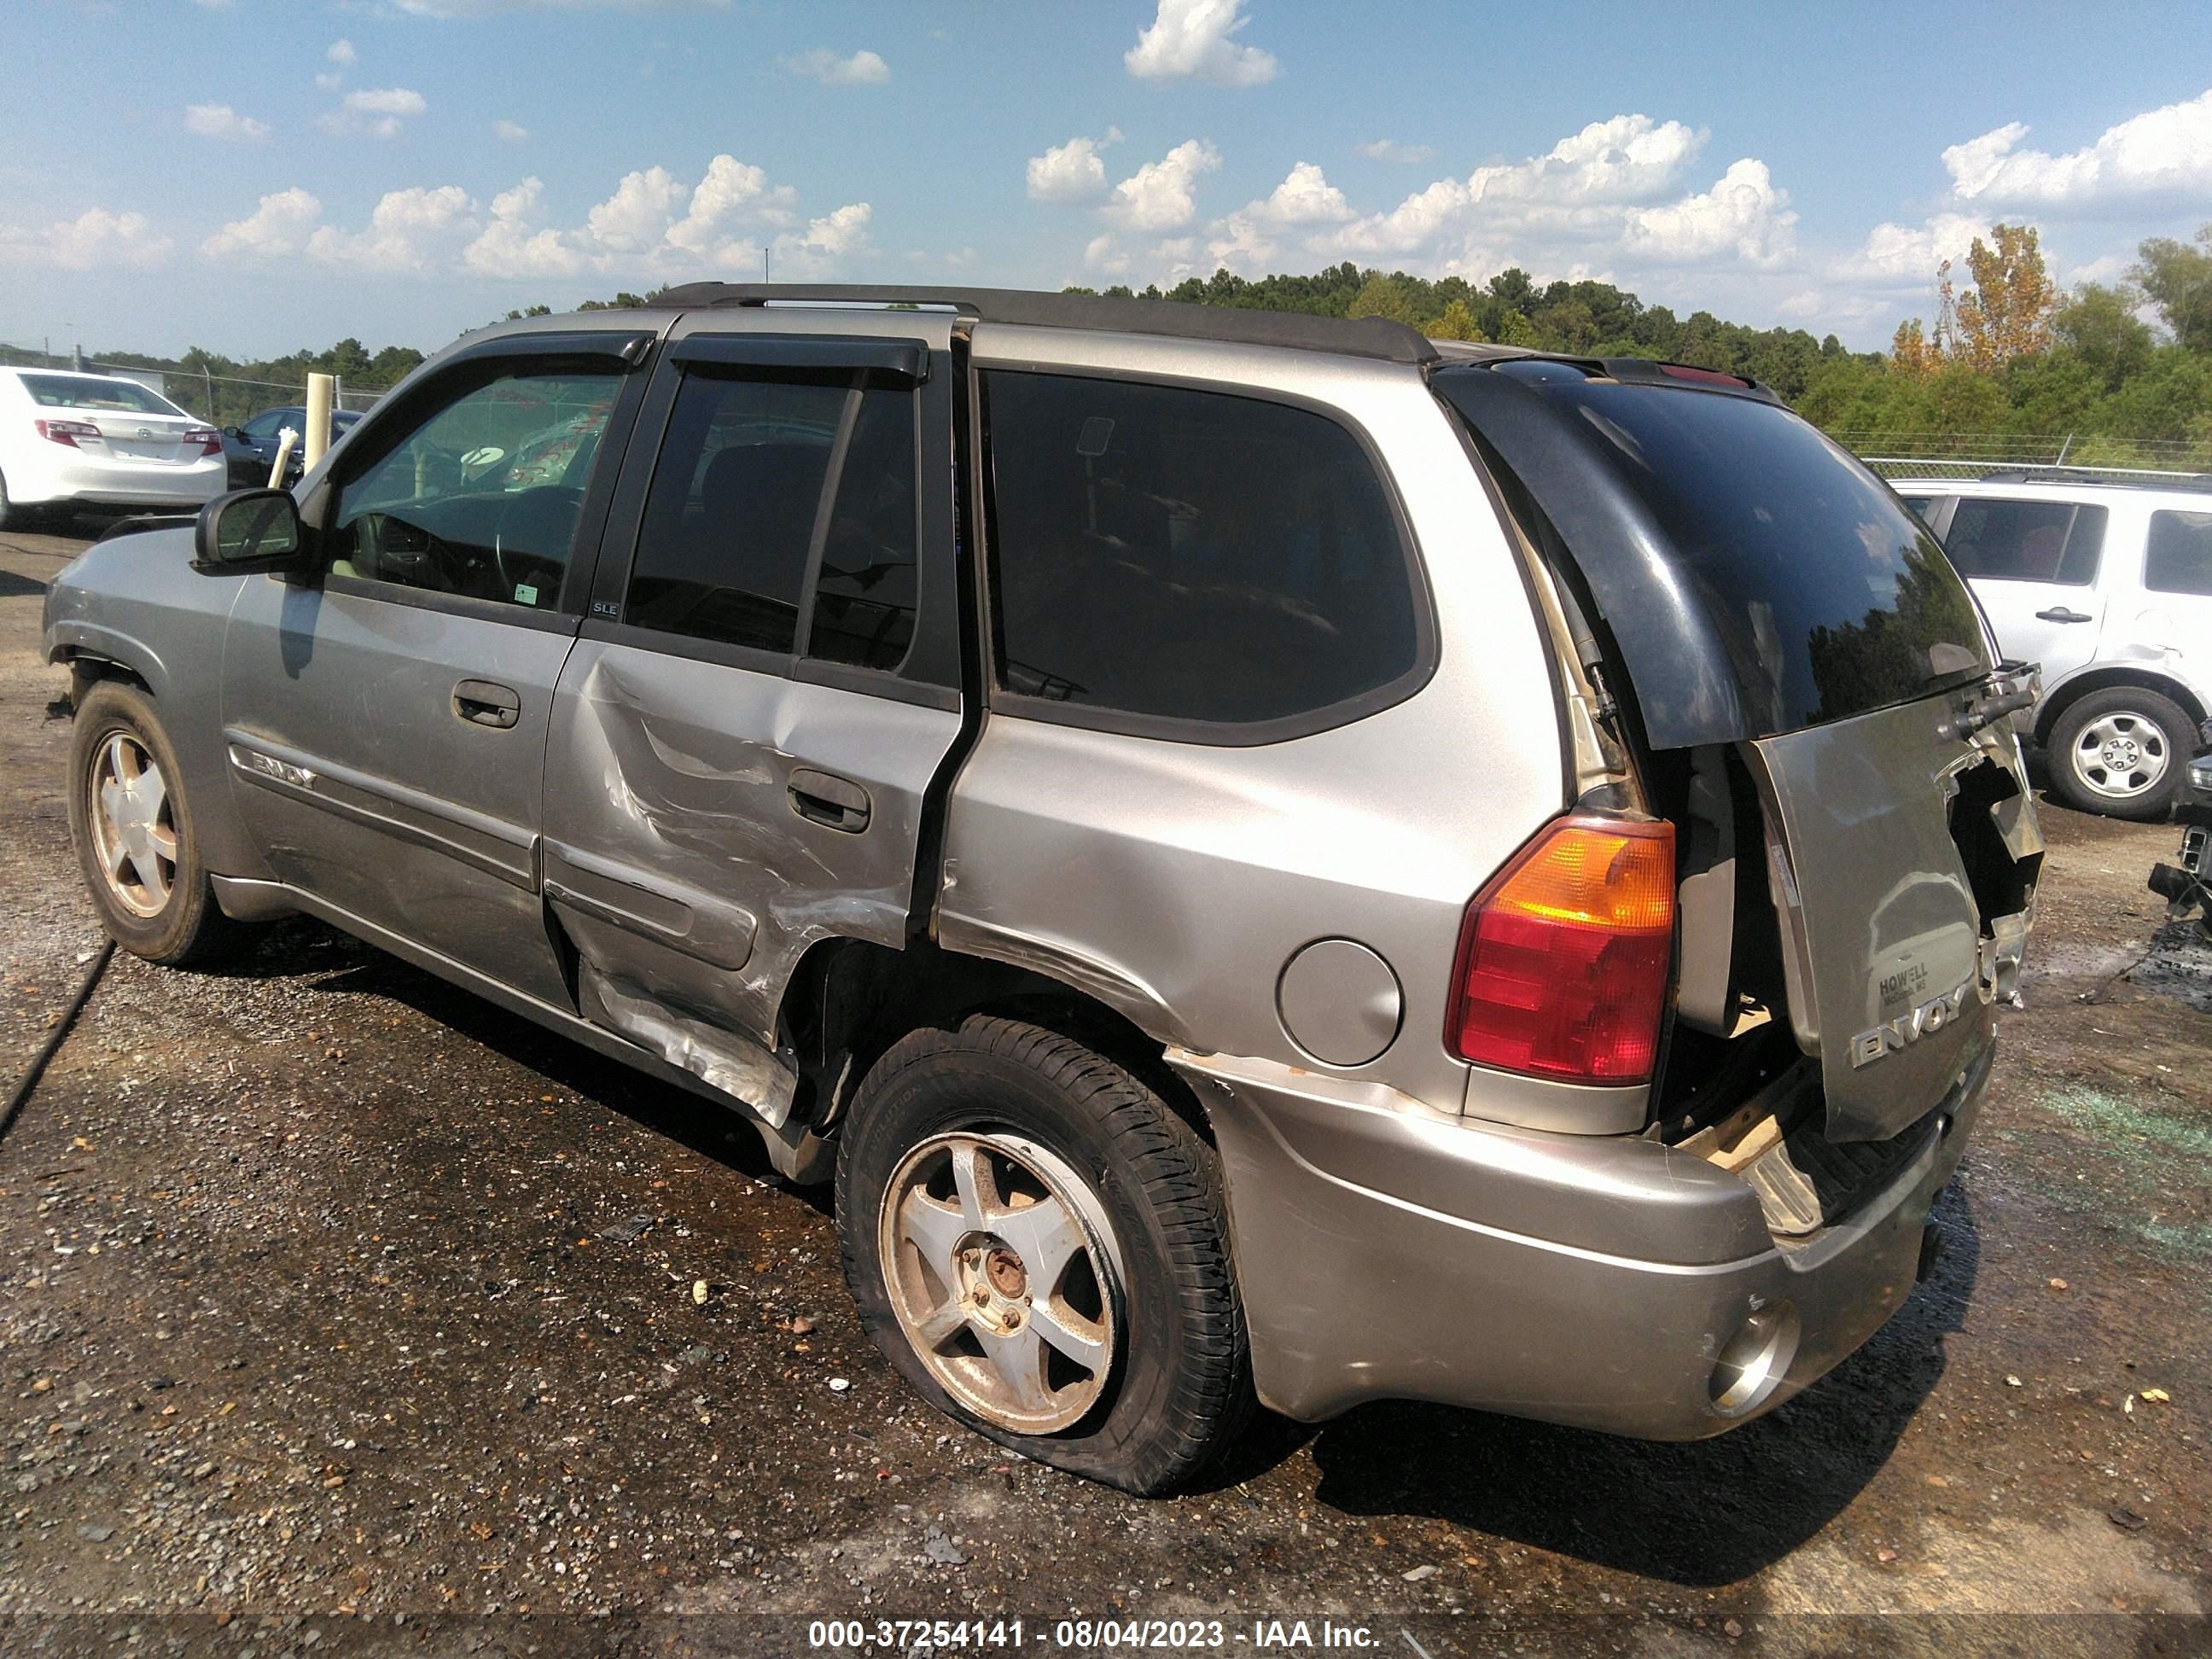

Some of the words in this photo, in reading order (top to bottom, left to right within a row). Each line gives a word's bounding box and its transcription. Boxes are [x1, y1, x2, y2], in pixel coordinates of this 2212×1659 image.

[593, 602, 617, 615] SLE
[252, 752, 317, 790] ENVOY
[1879, 962, 1928, 996] HOWELL
[1851, 985, 1966, 1068] ENVOY
